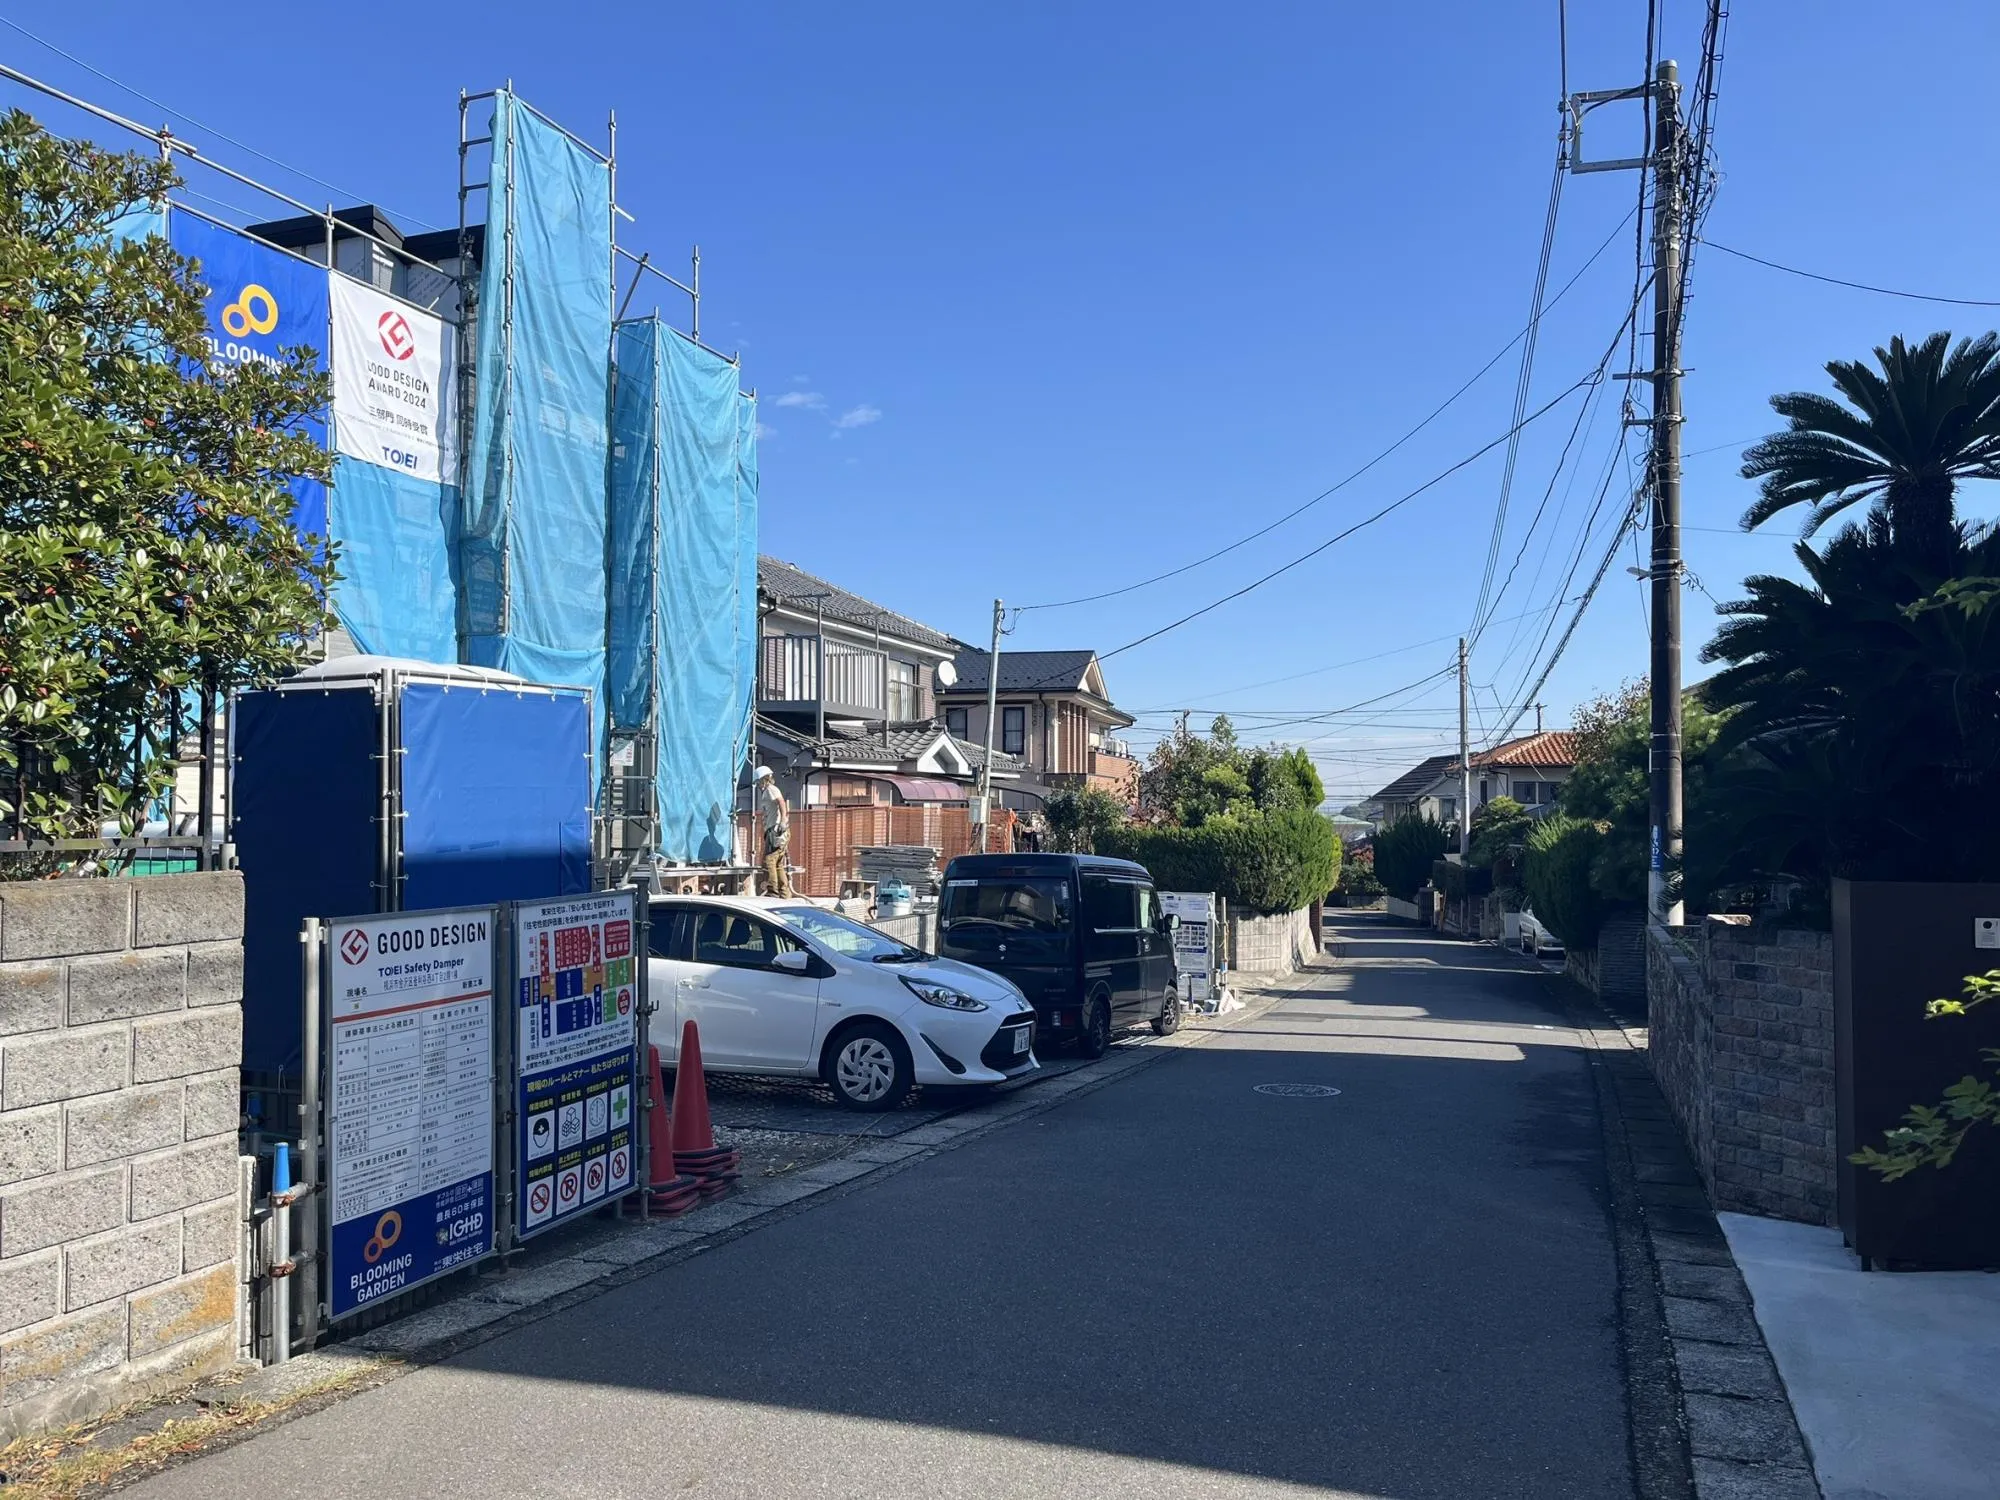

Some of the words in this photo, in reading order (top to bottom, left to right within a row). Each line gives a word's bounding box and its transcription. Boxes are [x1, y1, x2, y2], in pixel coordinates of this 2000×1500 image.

[393, 370, 430, 394] DESIGN
[403, 390, 427, 409] 2024
[377, 929, 424, 955] GOOD
[430, 921, 487, 948] DESIGN
[404, 961, 431, 974] Safety
[433, 958, 465, 971] Damper
[442, 1242, 484, 1267] 東栄住宅
[350, 1253, 412, 1290] BLOOMING
[357, 1272, 405, 1303] GARDEN
